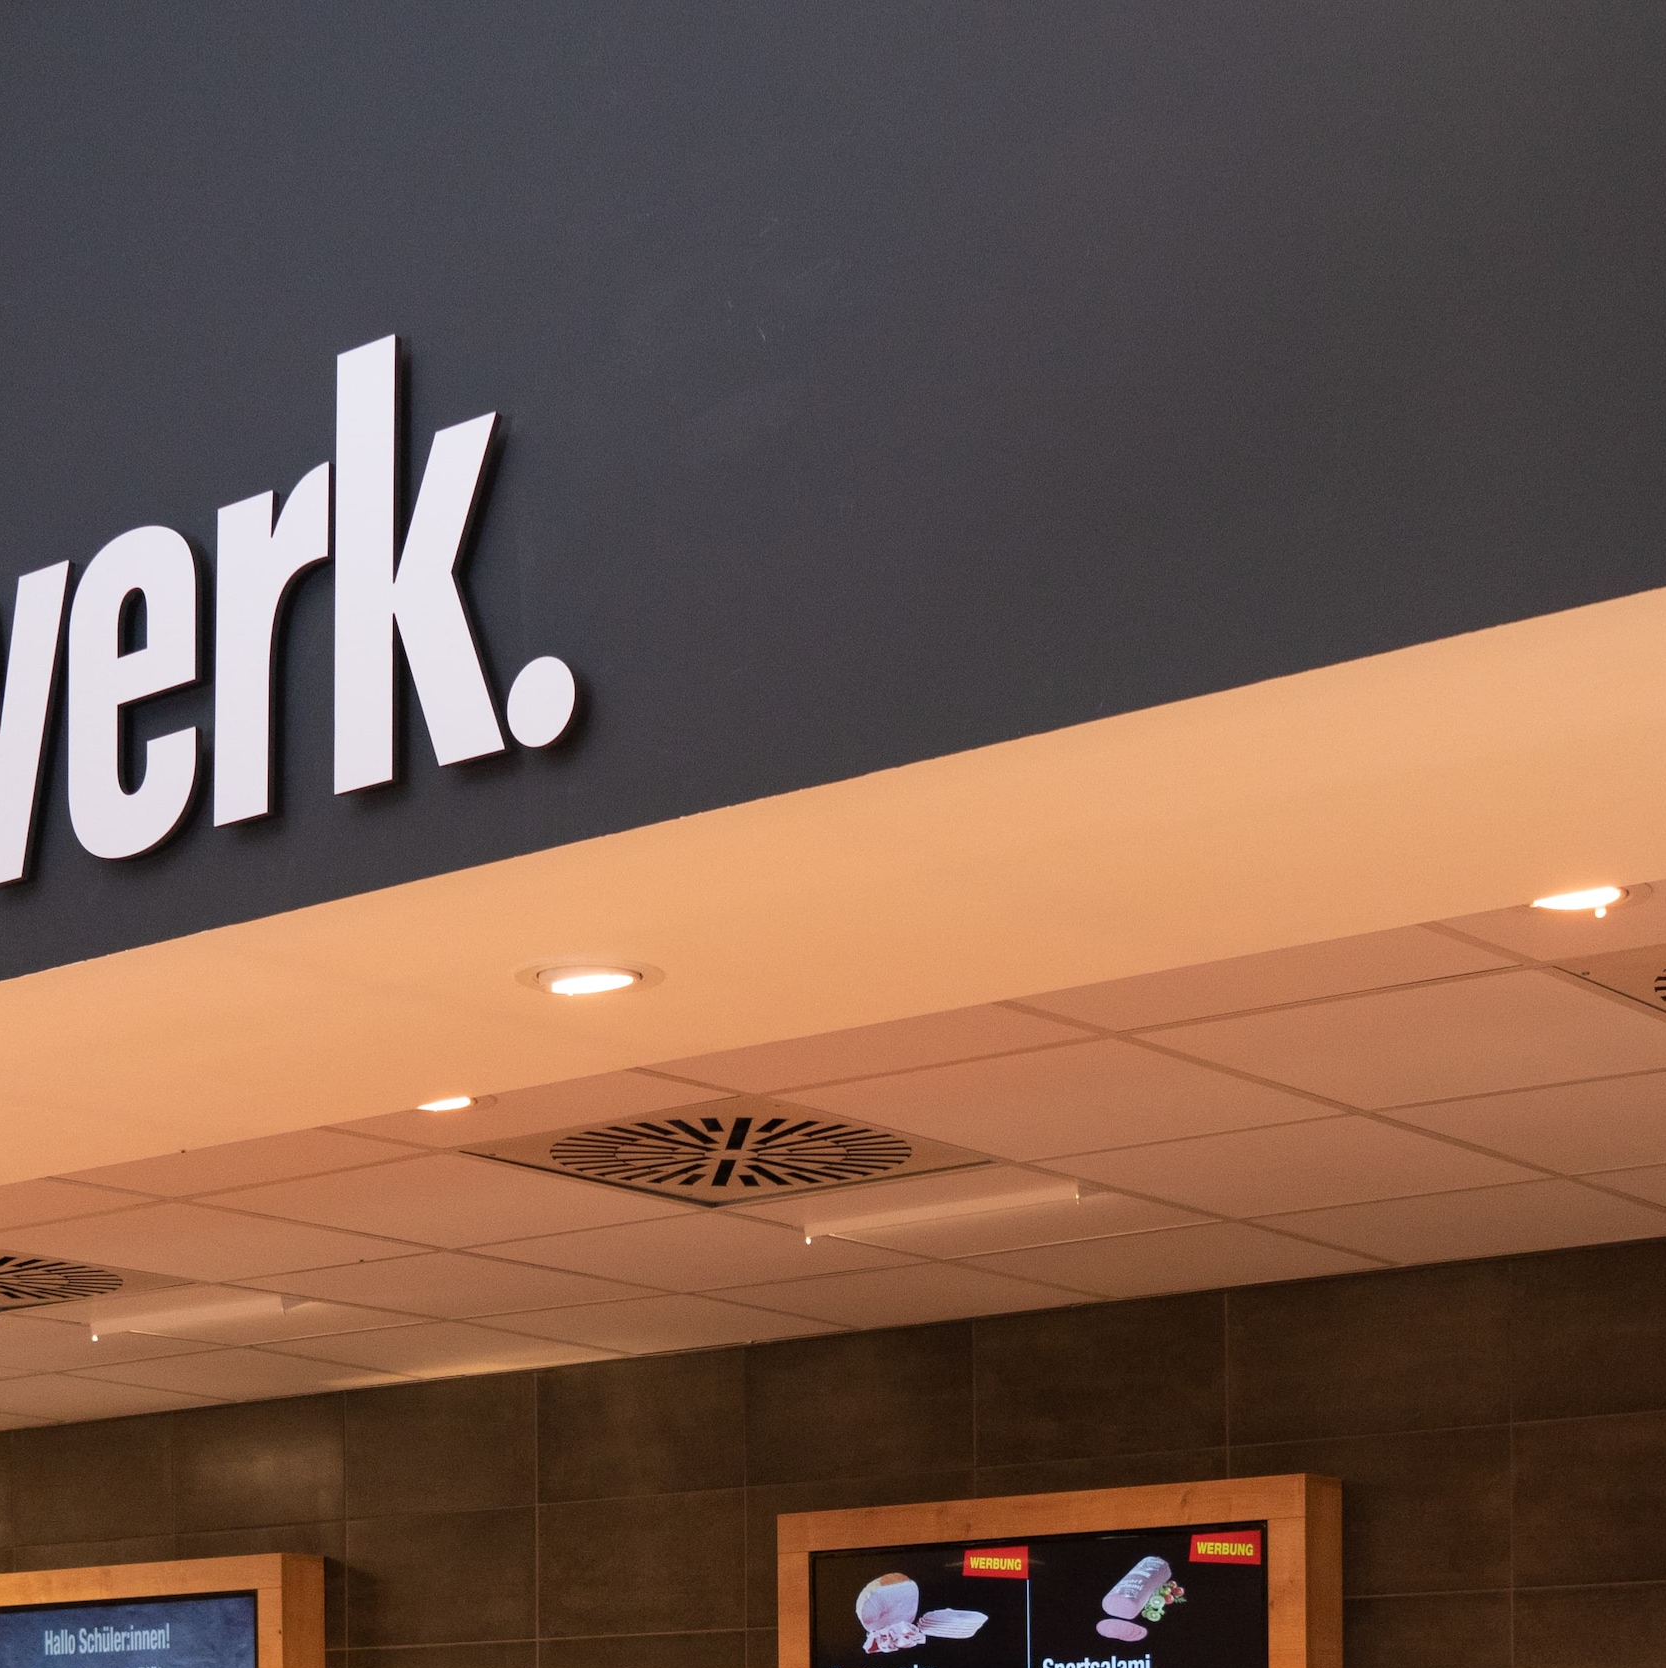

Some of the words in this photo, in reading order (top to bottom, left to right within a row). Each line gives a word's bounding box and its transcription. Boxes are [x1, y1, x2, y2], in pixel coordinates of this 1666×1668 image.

[1196, 1540, 1254, 1558] WERBUNG
[969, 1555, 1022, 1573] WERBUNG
[44, 1629, 75, 1655] Hallo
[79, 1623, 170, 1653] Schüler:innen!
